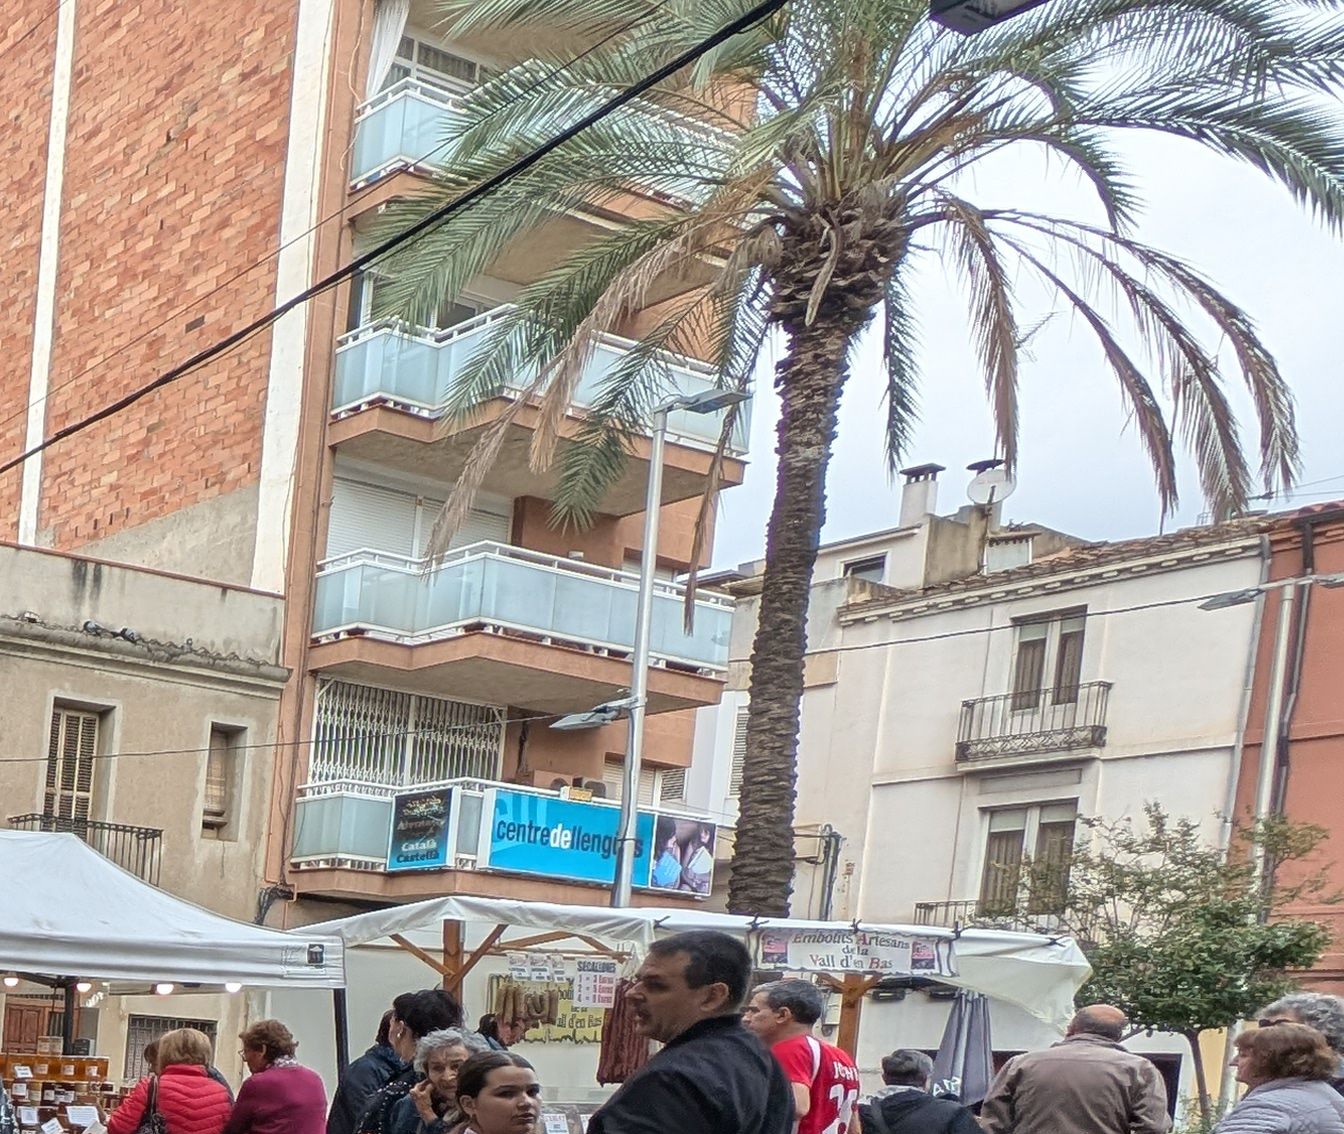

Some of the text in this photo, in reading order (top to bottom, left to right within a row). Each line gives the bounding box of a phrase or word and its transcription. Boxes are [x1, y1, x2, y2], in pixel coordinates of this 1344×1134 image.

[496, 819, 643, 860] centredellengs
[856, 933, 910, 949] Artesans
[809, 954, 835, 967] Vall
[869, 957, 894, 969] Bas
